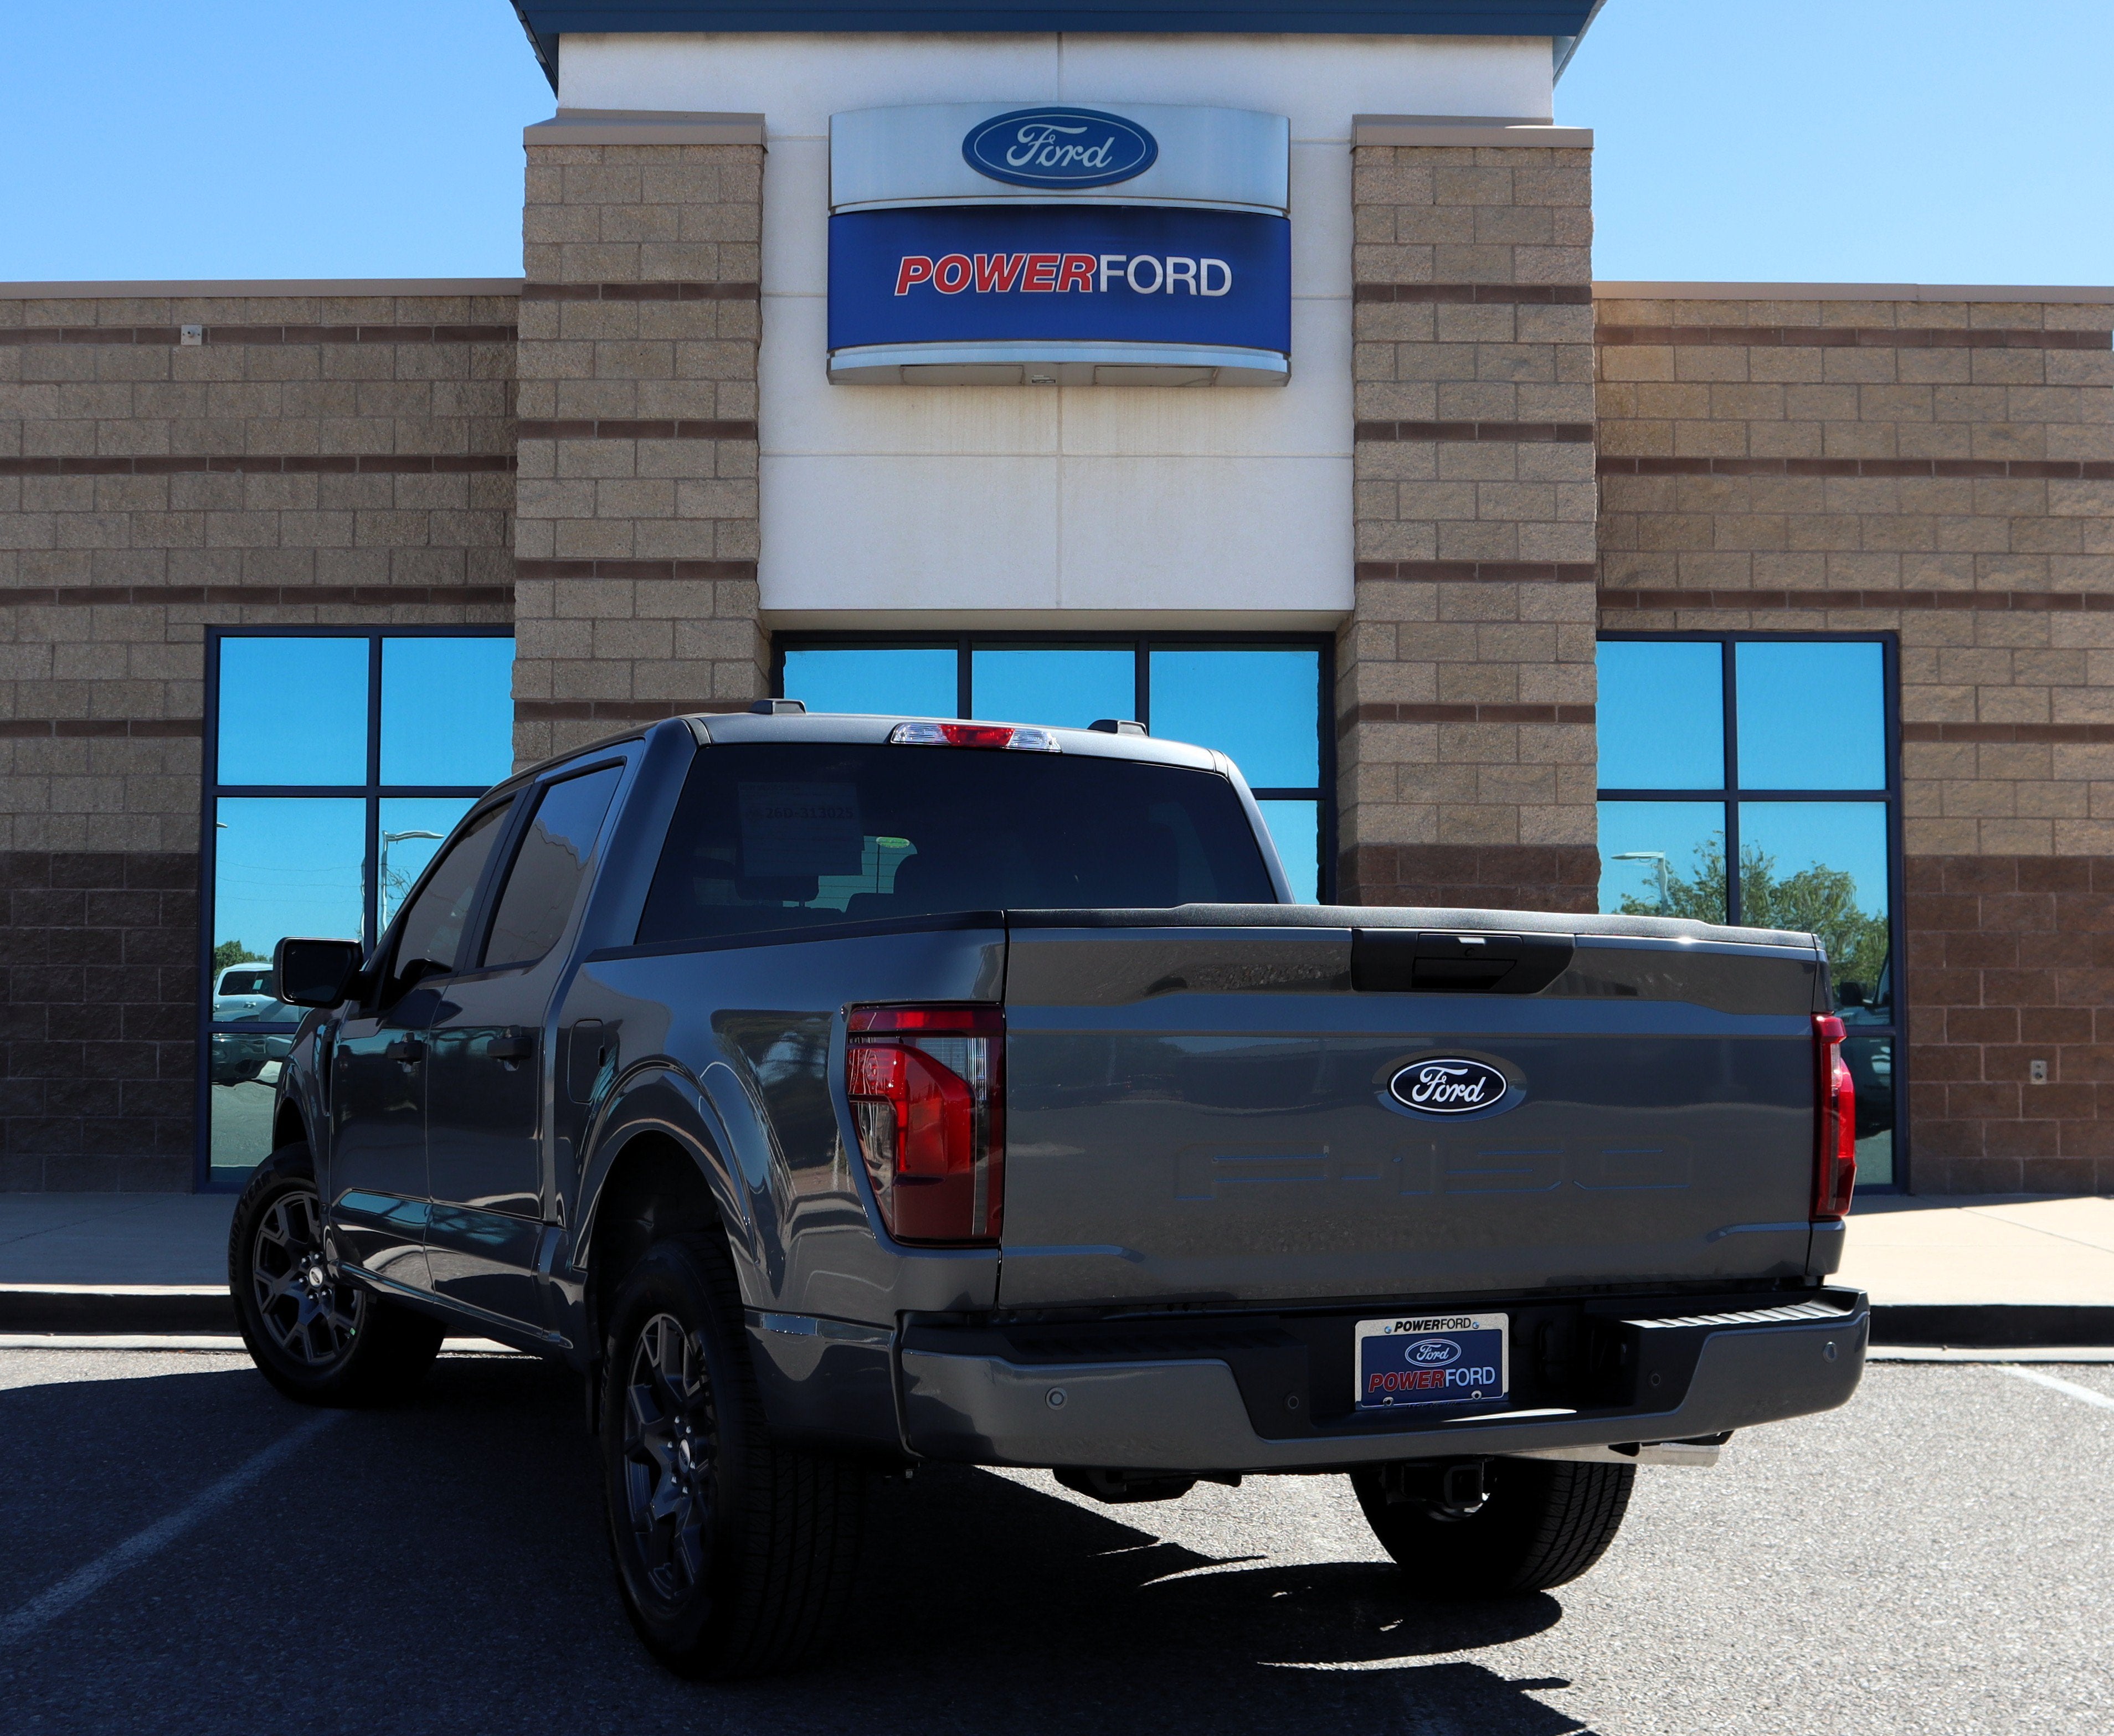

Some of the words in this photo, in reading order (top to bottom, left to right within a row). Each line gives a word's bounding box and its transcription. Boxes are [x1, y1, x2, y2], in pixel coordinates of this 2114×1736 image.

[1006, 124, 1114, 168] Ford
[894, 253, 1232, 296] POWERFORD
[765, 807, 853, 819] 26D-313025
[1412, 1067, 1485, 1103] Ford
[1394, 1318, 1471, 1332] POWERFORD
[1416, 1344, 1449, 1361] Ford
[1369, 1367, 1495, 1393] POWERFORD
